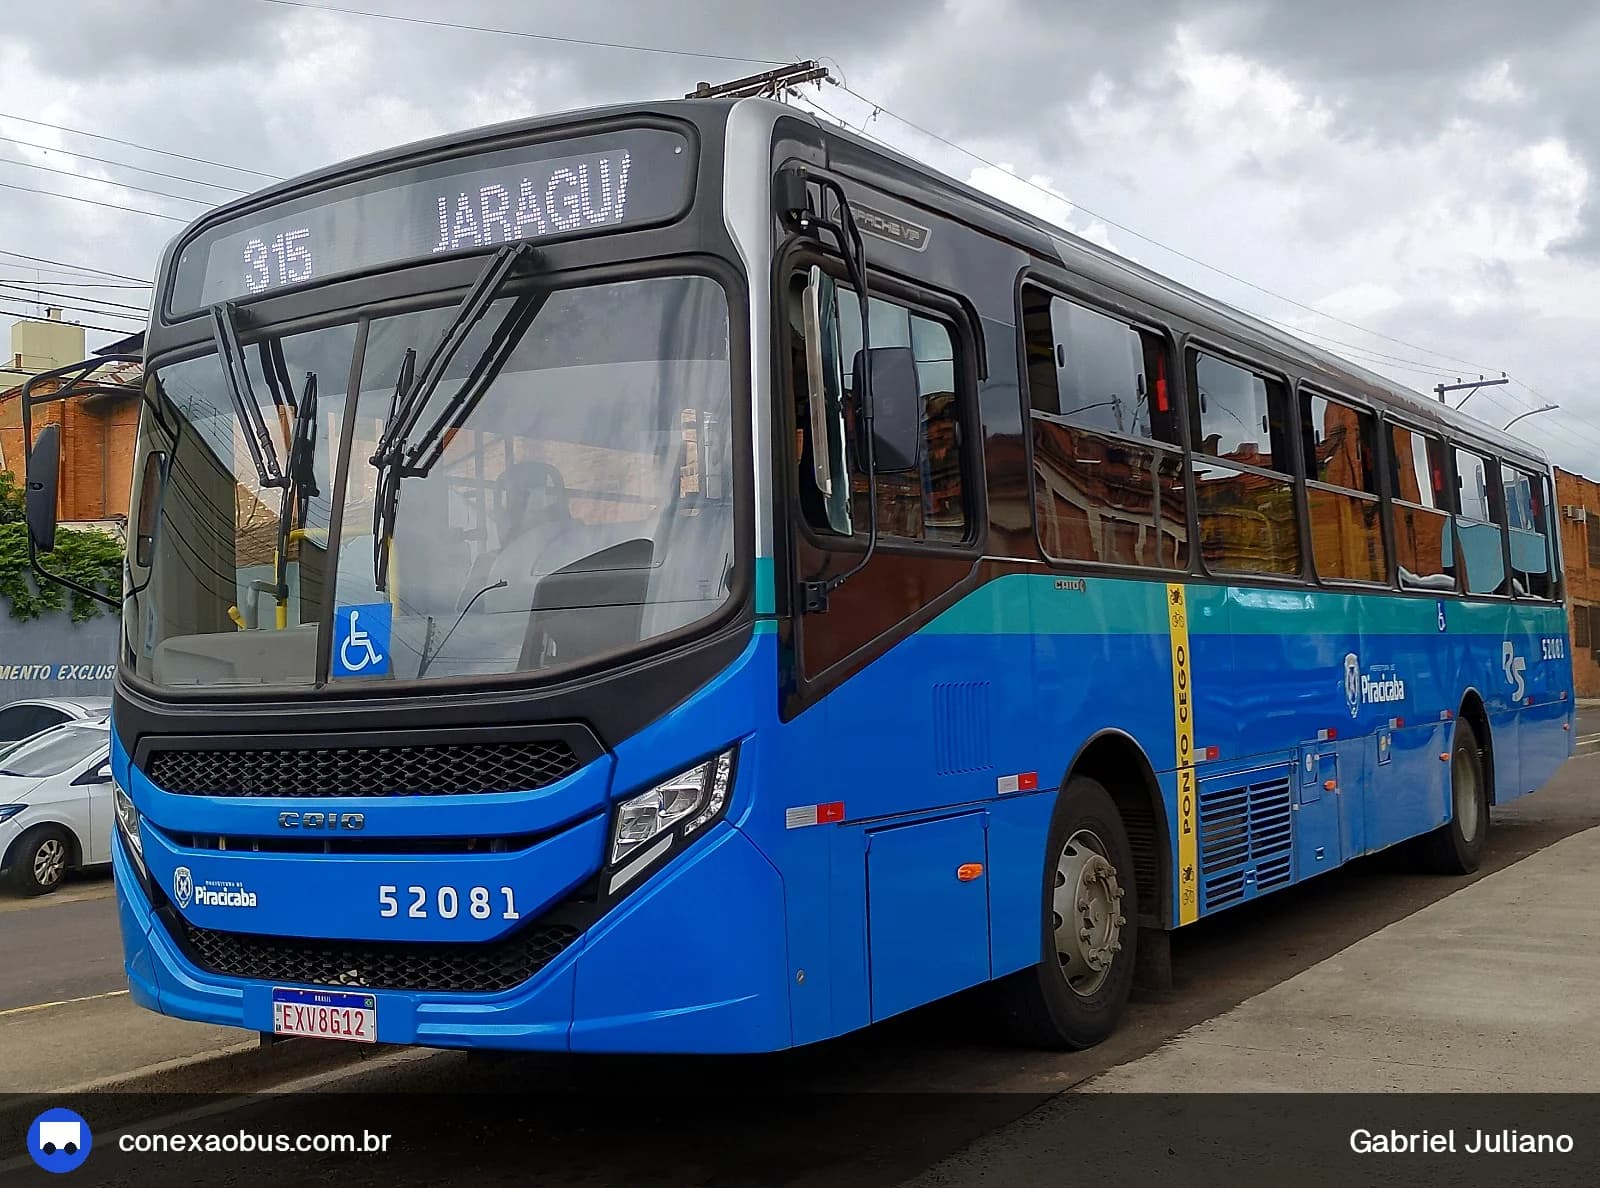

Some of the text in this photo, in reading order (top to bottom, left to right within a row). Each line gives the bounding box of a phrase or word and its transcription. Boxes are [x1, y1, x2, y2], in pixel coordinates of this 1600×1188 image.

[242, 227, 313, 294] 315
[1361, 673, 1405, 704] Piracicaba
[1176, 645, 1192, 834] PONTO CEGO
[194, 886, 257, 907] Piracicaba
[378, 884, 520, 920] 52081
[283, 1004, 365, 1037] EXV8G12
